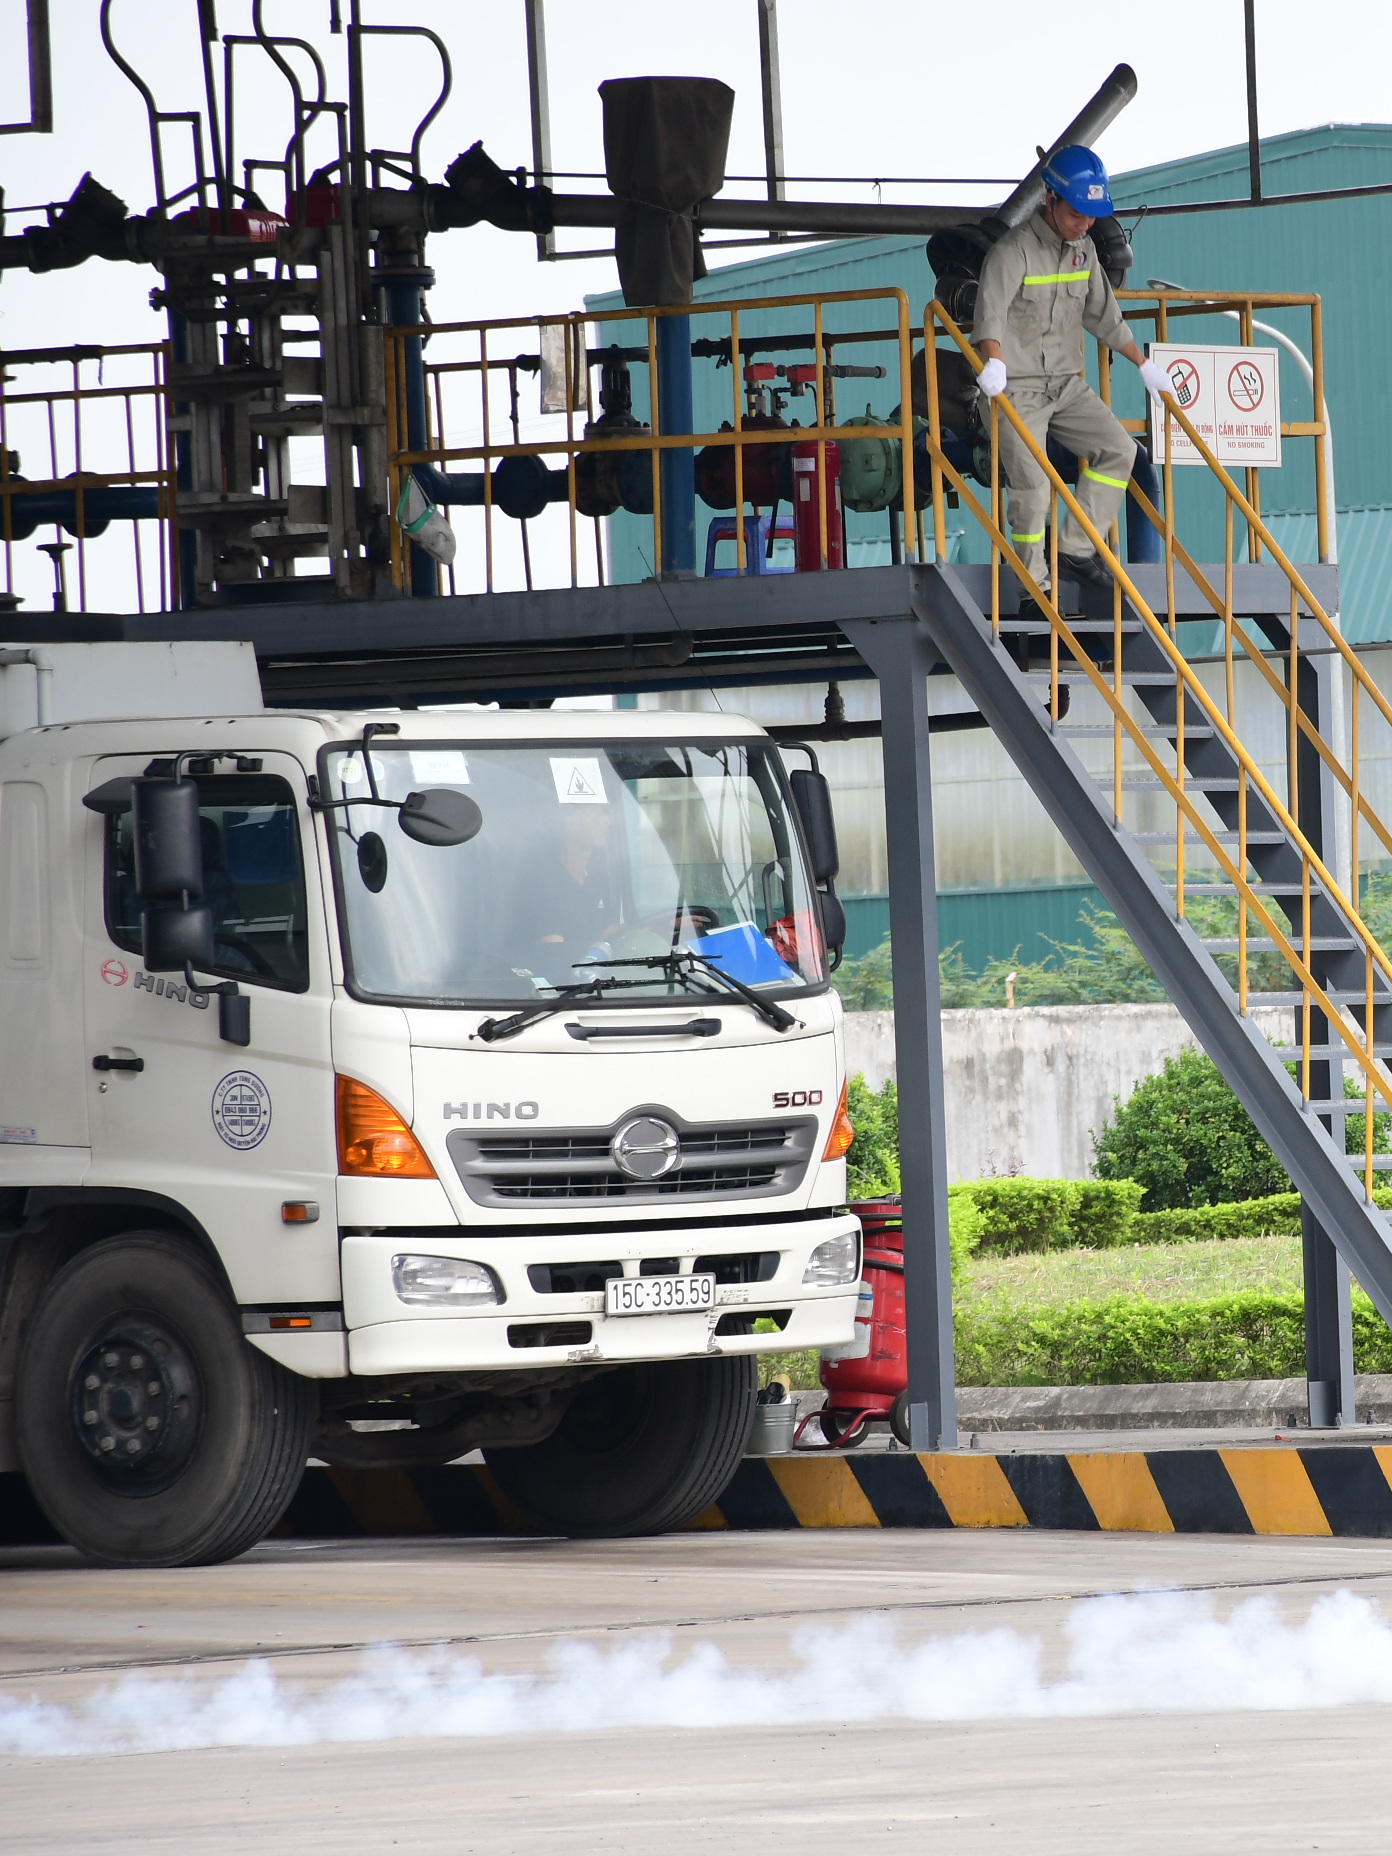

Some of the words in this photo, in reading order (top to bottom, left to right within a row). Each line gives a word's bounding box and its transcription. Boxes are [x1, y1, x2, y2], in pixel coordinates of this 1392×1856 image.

[1218, 420, 1234, 436] CẤM
[1236, 421, 1249, 436] HÚT
[1250, 421, 1273, 437] THUỐC
[134, 972, 210, 1009] HINO
[772, 1090, 823, 1109] 500
[443, 1101, 539, 1120] HINO
